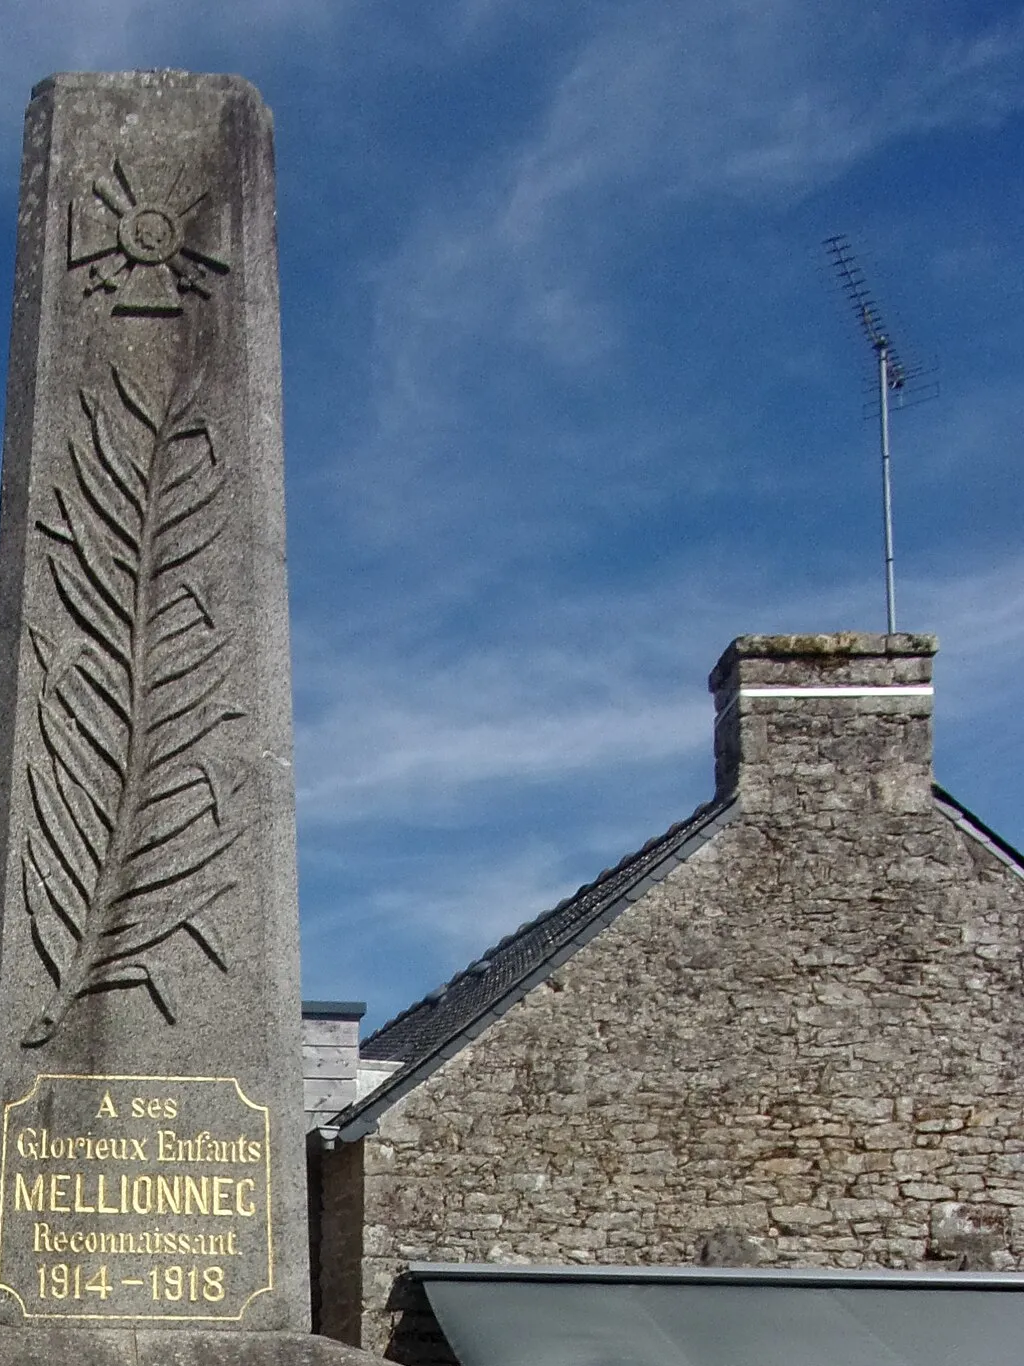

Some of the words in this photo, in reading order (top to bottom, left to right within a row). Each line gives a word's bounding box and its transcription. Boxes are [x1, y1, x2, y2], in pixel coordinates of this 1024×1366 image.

[96, 1090, 118, 1118] A
[132, 1097, 178, 1119] ses
[17, 1127, 149, 1161] Glorieux
[157, 1130, 261, 1163] Enfants
[14, 1172, 256, 1217] MELLIONNEC
